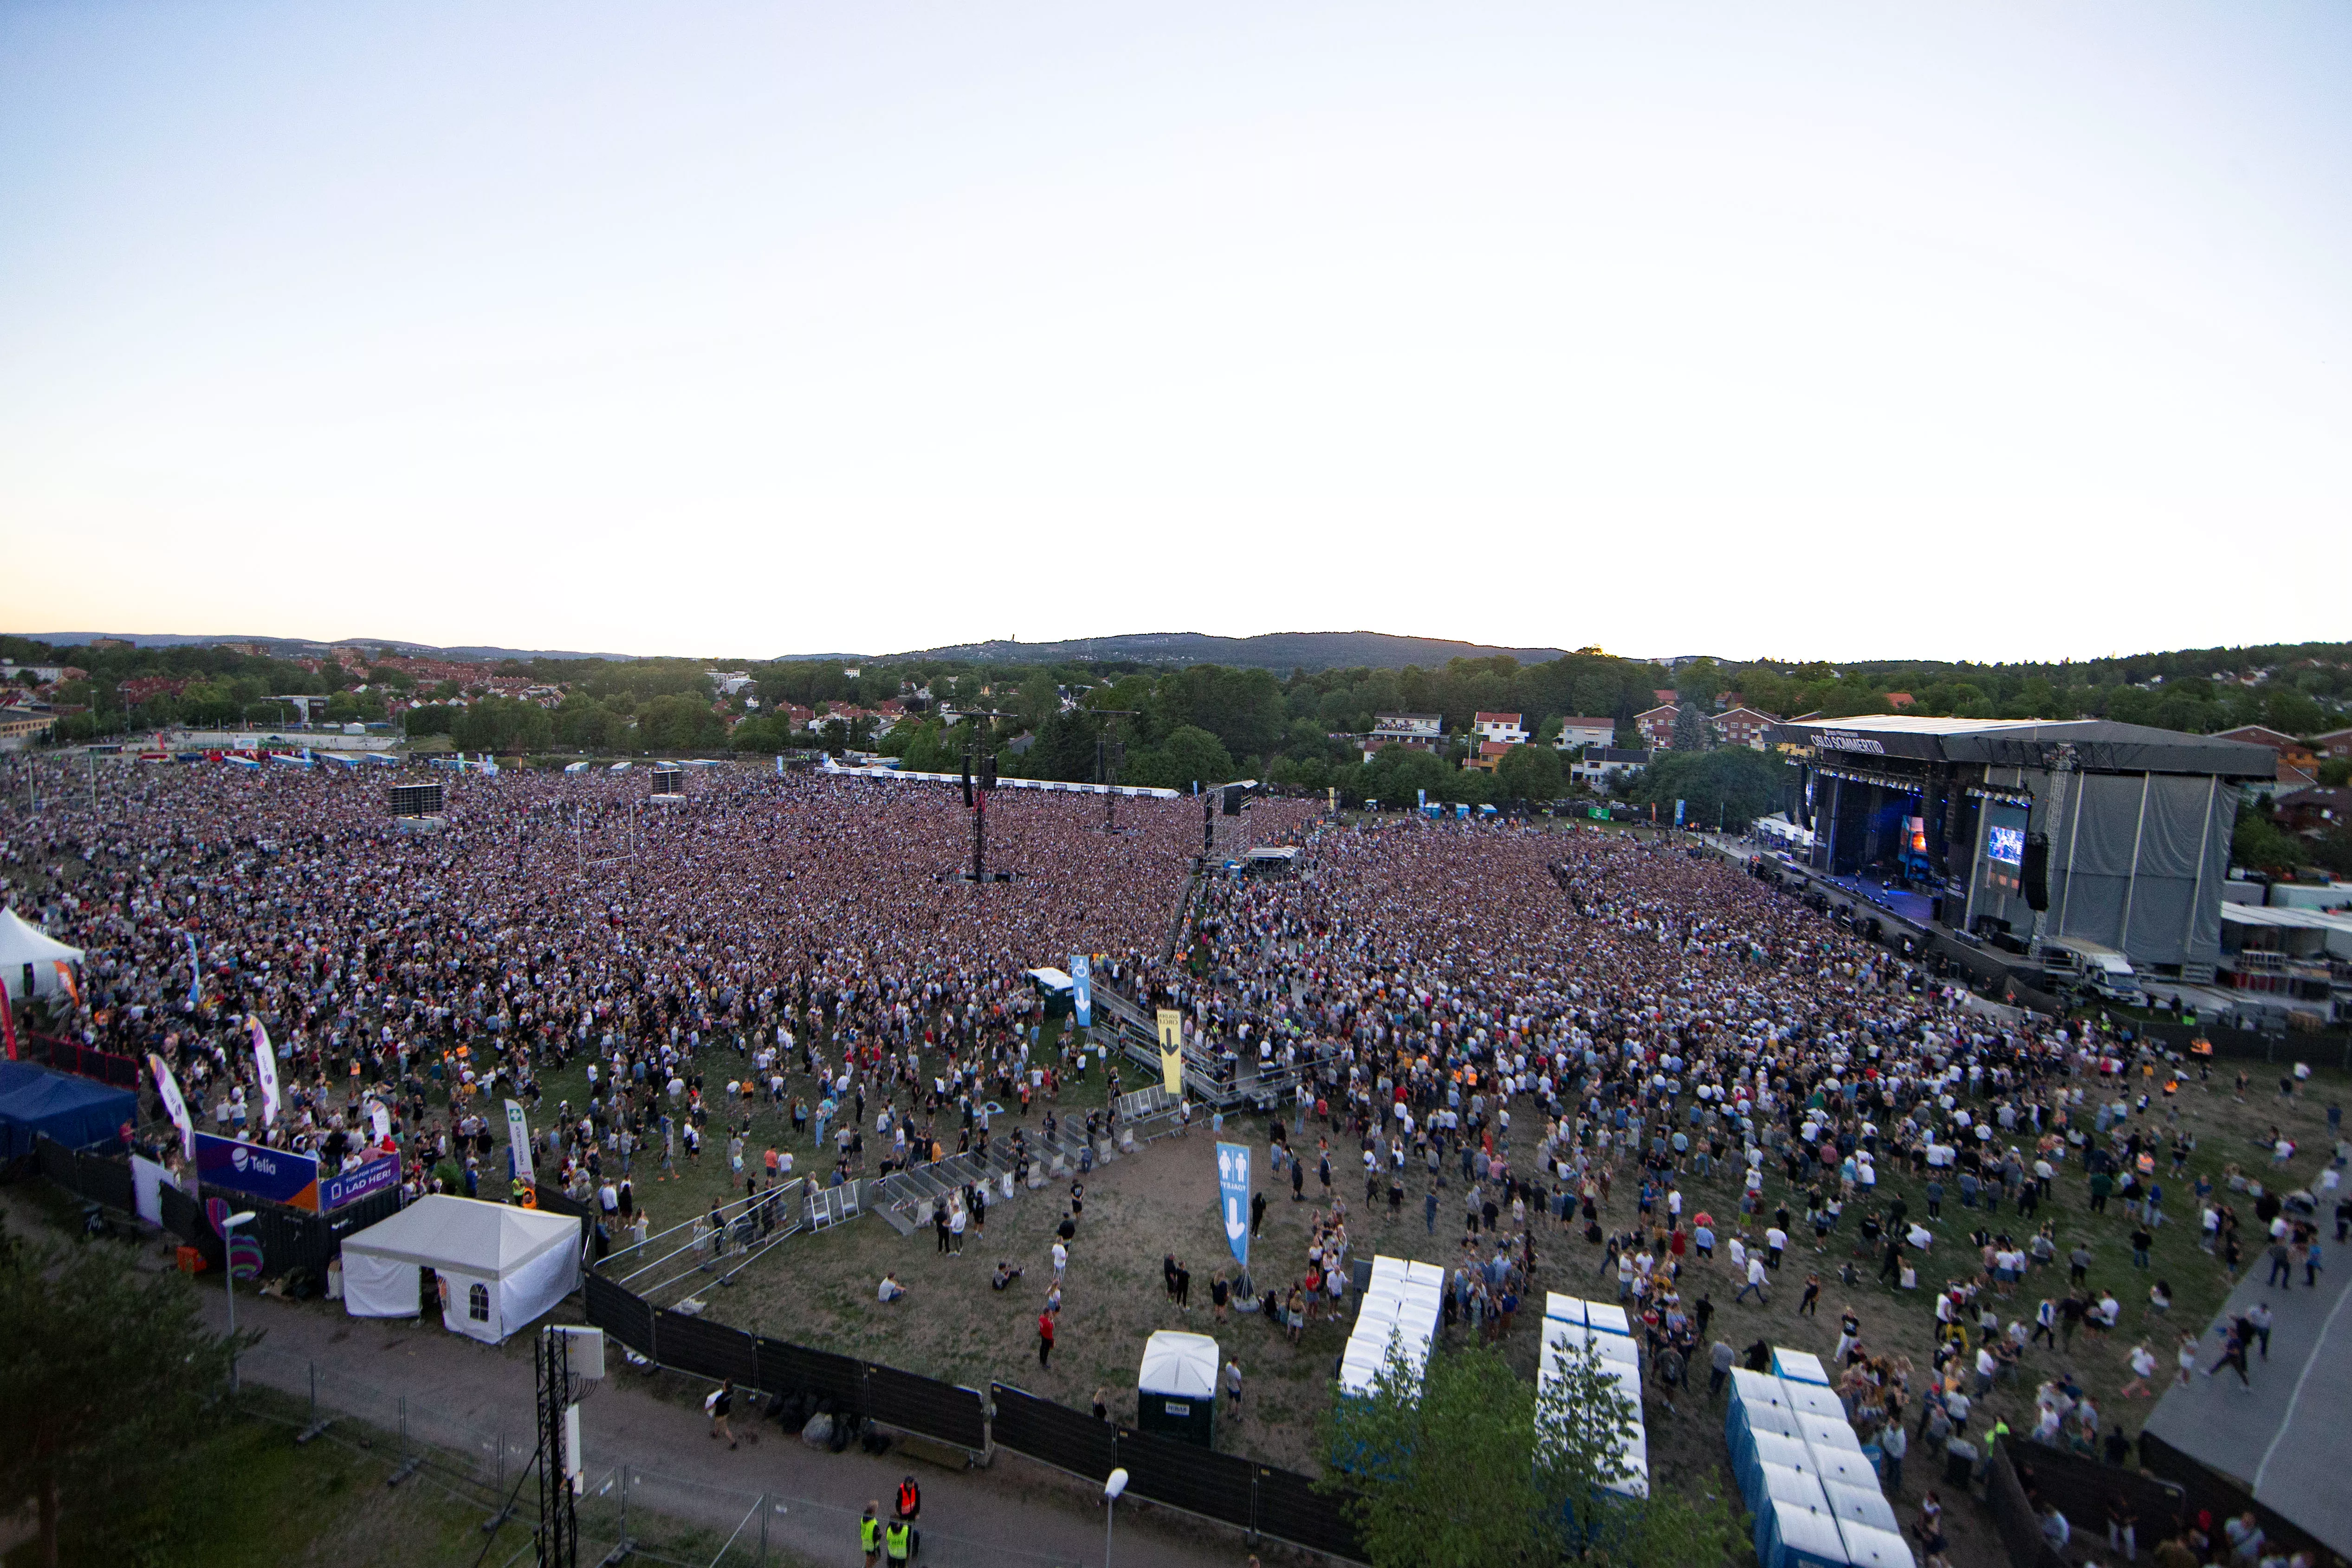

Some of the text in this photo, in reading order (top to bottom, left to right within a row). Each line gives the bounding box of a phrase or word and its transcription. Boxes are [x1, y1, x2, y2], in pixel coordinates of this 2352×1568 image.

[1810, 734, 1885, 754] OSLO SOMMERTID
[250, 1155, 276, 1175] Telia
[346, 1175, 358, 1183] TOM
[358, 1170, 369, 1178] FOR
[346, 1169, 391, 1194] LAD HER!
